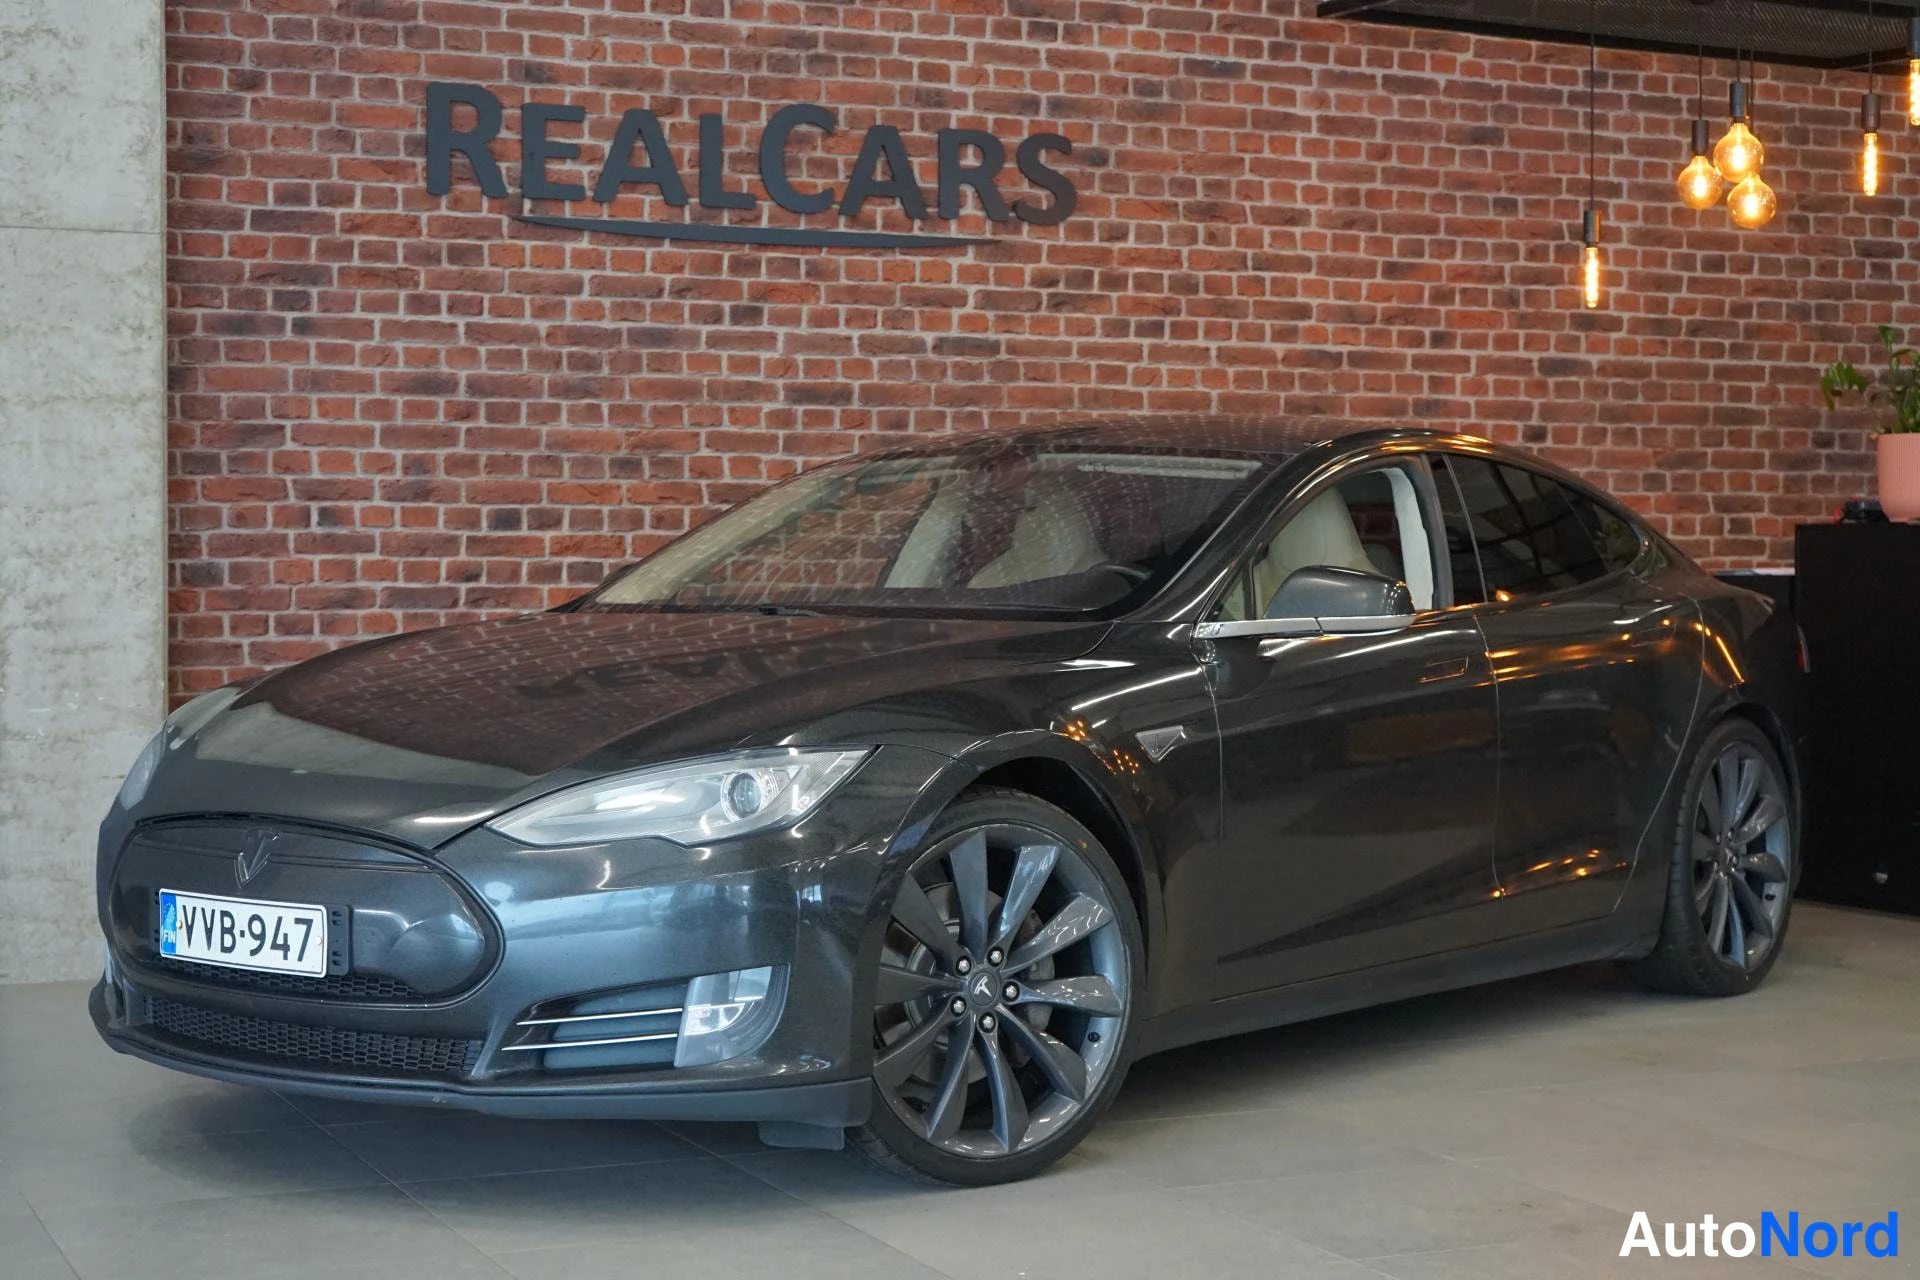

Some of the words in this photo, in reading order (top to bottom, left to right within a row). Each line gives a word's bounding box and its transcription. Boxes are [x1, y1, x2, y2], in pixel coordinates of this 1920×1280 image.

[426, 81, 1077, 226] REALCARS
[163, 929, 176, 944] FIN
[182, 904, 314, 962] VVB-947
